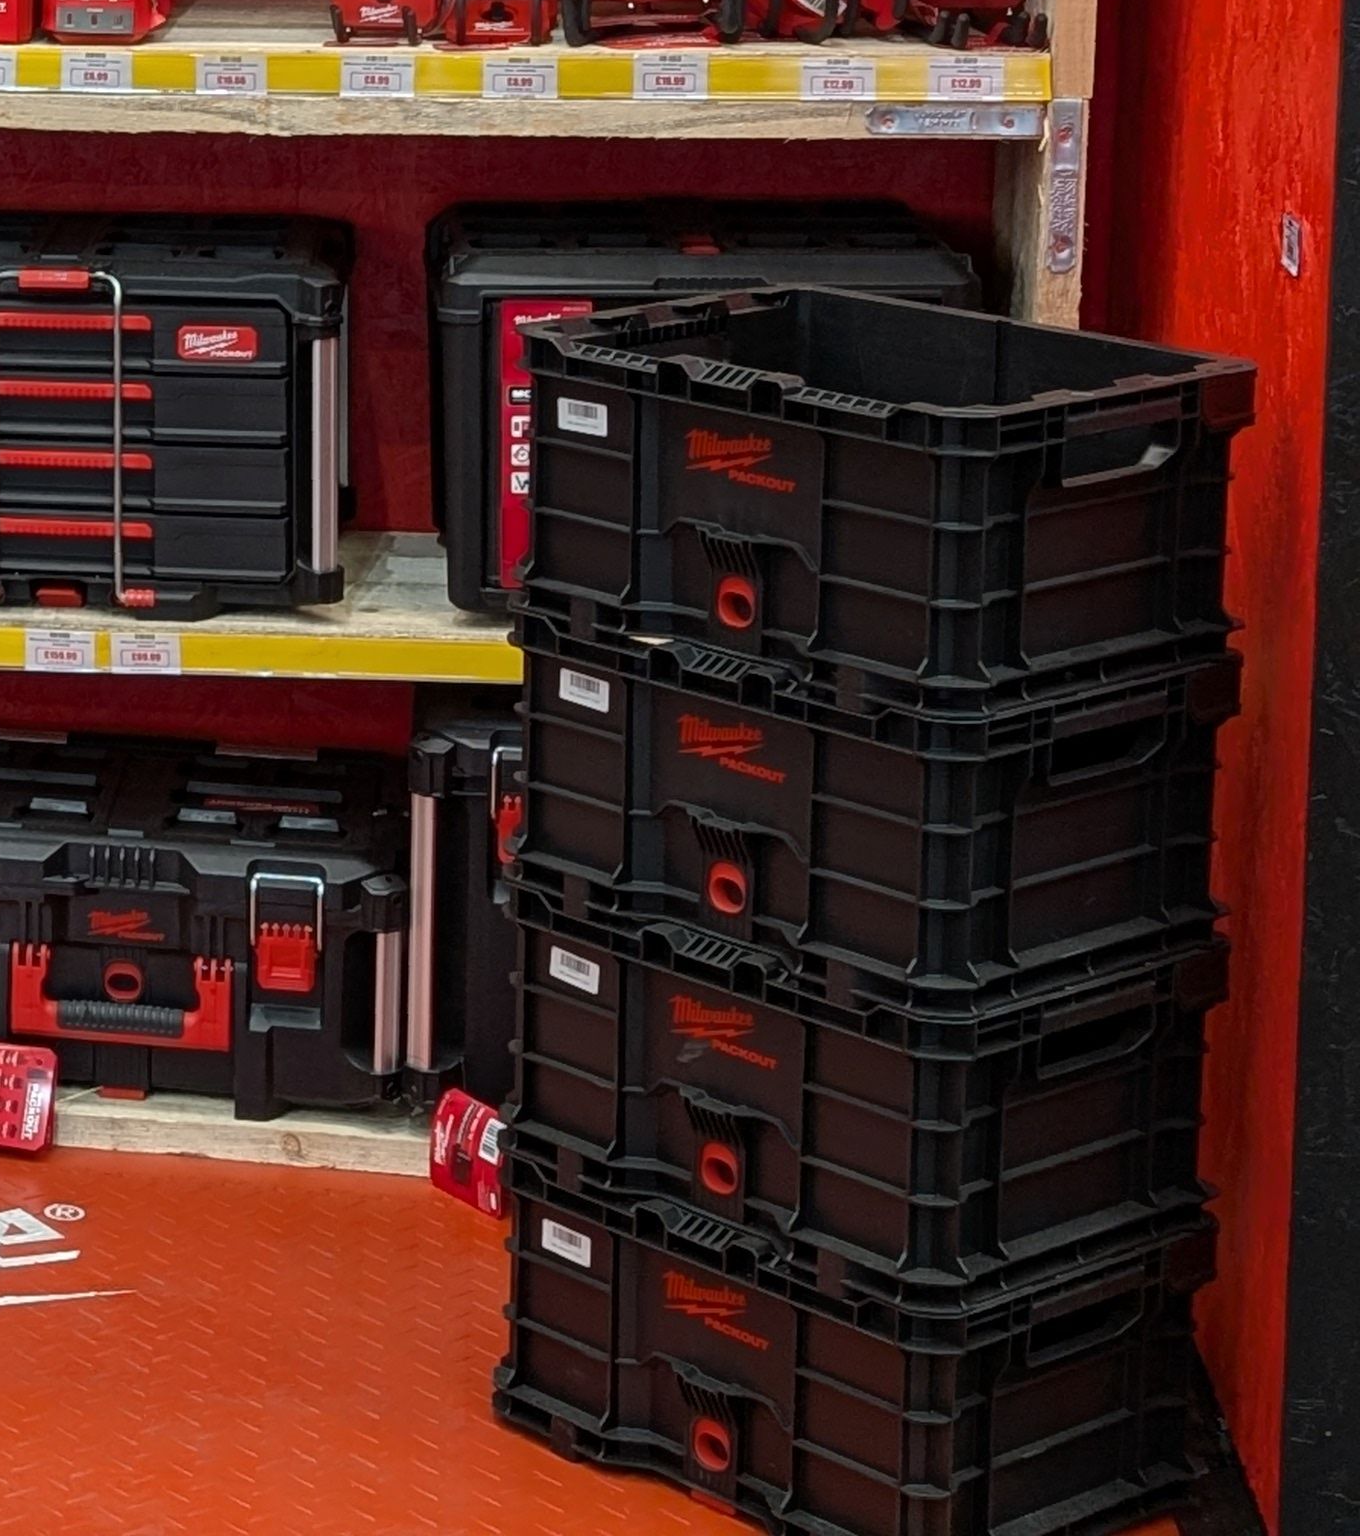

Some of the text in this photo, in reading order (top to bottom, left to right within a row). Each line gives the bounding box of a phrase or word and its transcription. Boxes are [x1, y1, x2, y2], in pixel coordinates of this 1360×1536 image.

[183, 329, 239, 349] Milwaukee
[210, 349, 254, 359] PACKOUT
[683, 429, 773, 459] Milwaukee
[728, 468, 796, 493] PACKOUT
[676, 714, 764, 742] Milwaukee
[719, 755, 787, 784] PACKOUT
[89, 910, 148, 930] Milwaukee
[669, 994, 755, 1026] Milwaukee
[711, 1038, 778, 1070] PACKOUT
[20, 1082, 40, 1141] PACKOUT
[663, 1270, 747, 1306] Milwaukee
[704, 1316, 769, 1351] PACKOUT
